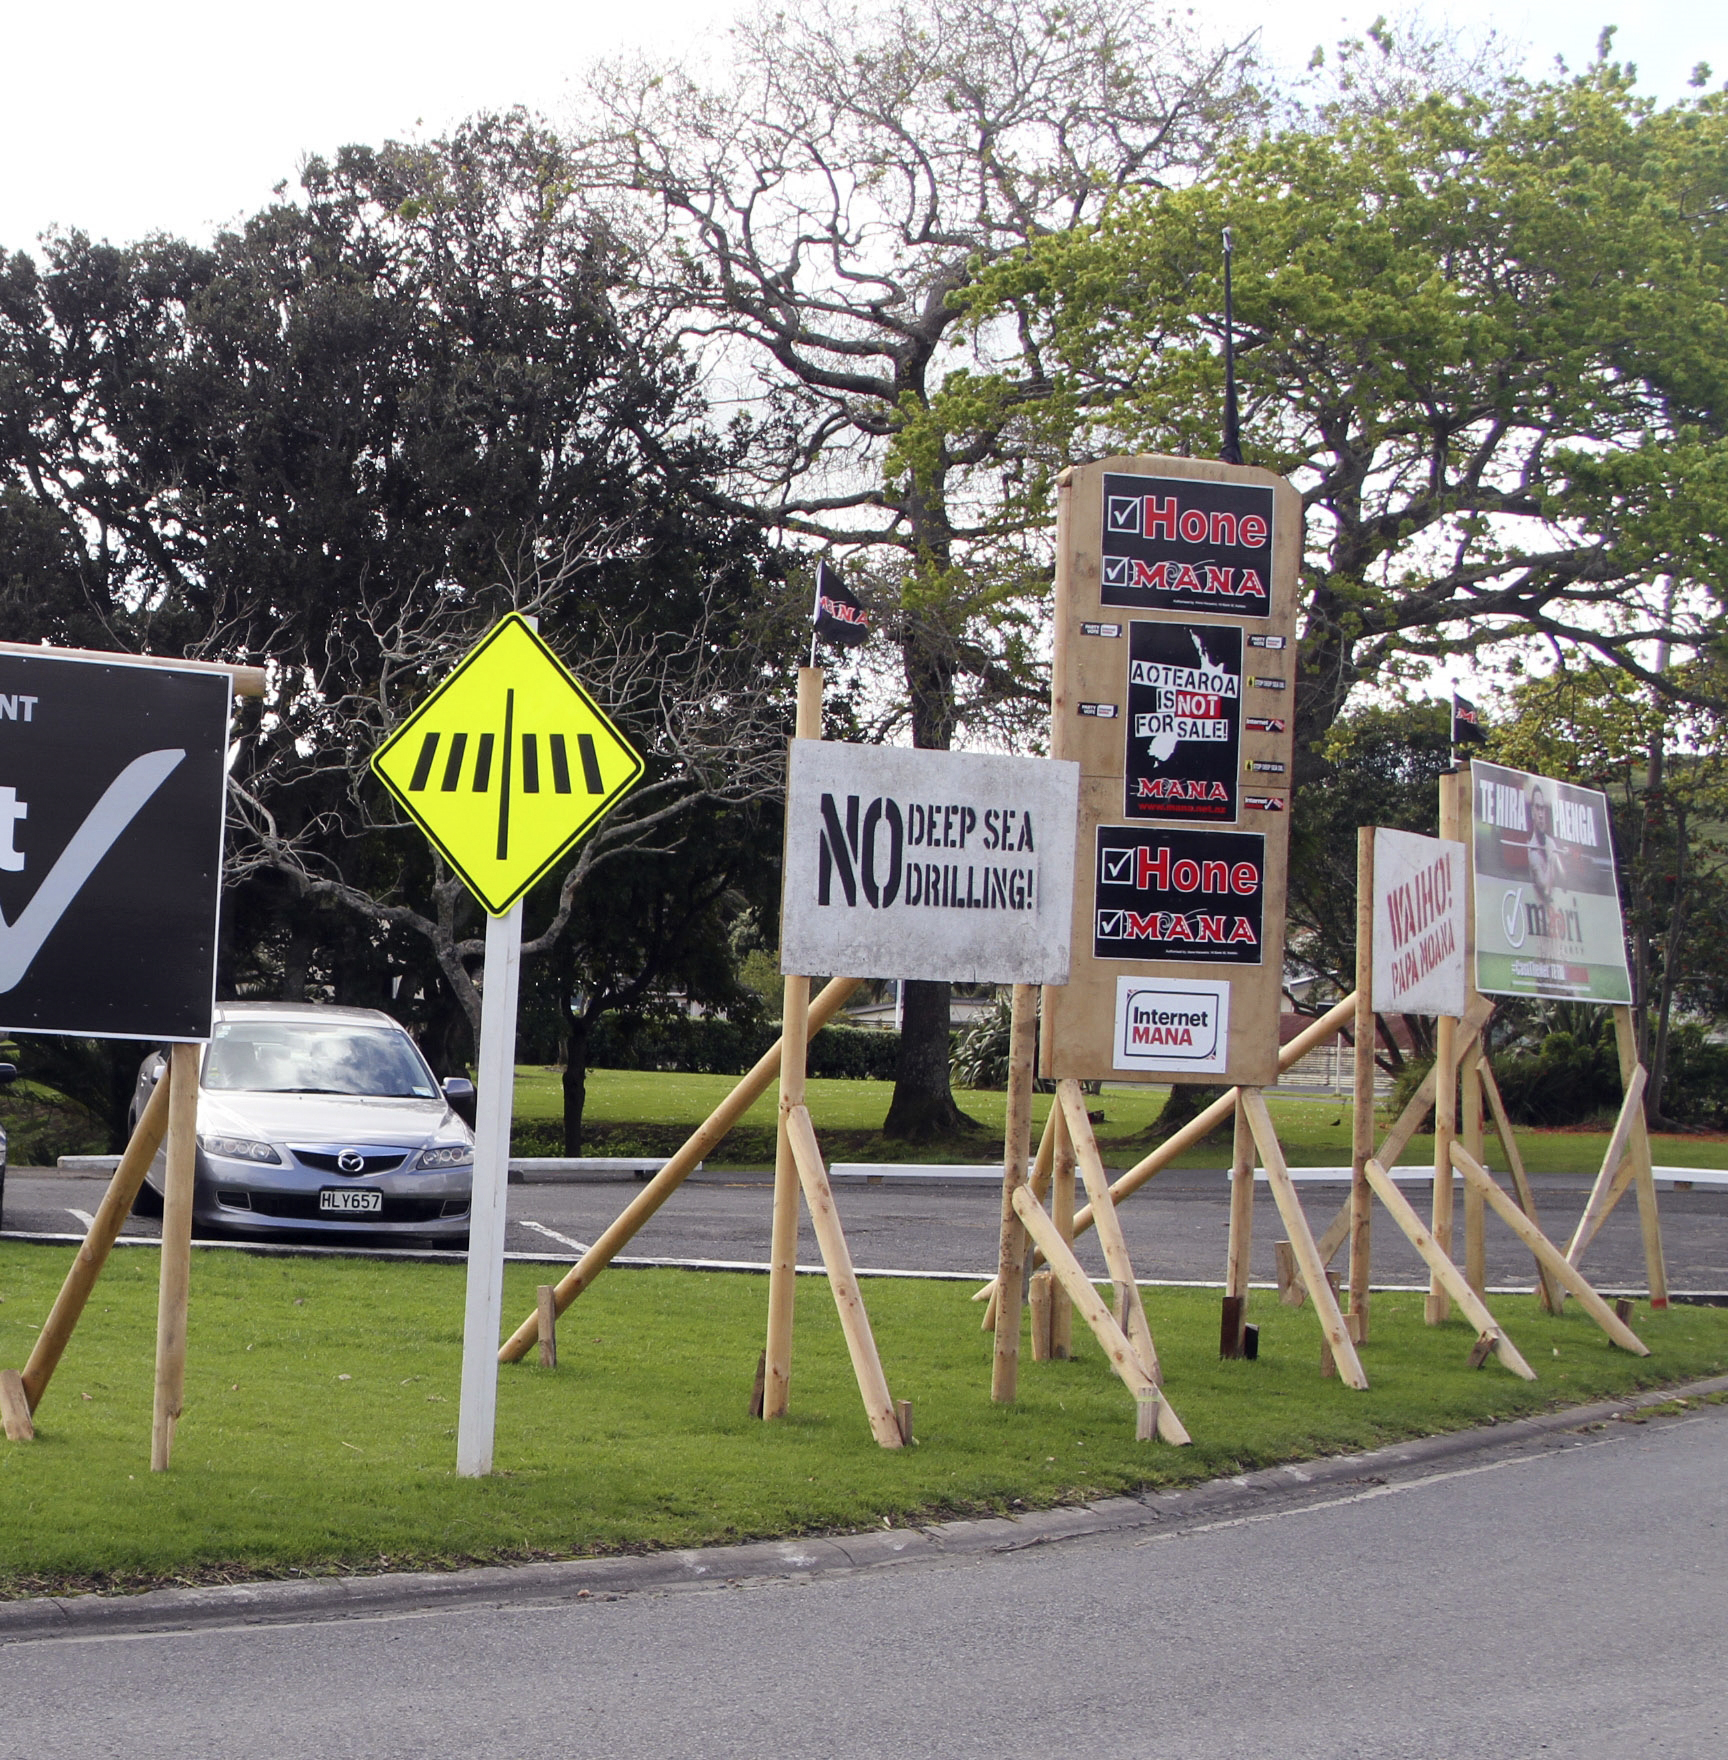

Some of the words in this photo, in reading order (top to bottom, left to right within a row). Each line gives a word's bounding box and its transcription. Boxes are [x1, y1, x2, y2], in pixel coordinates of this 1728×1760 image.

[1143, 495, 1267, 548] Hone
[1129, 560, 1266, 598] MANA
[1132, 662, 1236, 696] AOTEAROA
[1158, 690, 1174, 709] IS
[1177, 694, 1219, 716] NOT
[1136, 714, 1173, 735] FOR
[1176, 719, 1228, 739] SALE!
[1137, 778, 1228, 801] MANA
[907, 804, 976, 849] DEEP
[983, 809, 1035, 852] SEA
[1480, 779, 1495, 825] TE
[1495, 783, 1528, 832] HIRA
[1552, 800, 1598, 847] PAENGA
[818, 793, 903, 909] NO
[905, 862, 1033, 910] DRILLING!
[1137, 846, 1258, 896] Hone
[1387, 852, 1452, 952] WAIHO!
[1124, 910, 1257, 945] MANA
[1391, 948, 1420, 1000] PAPA
[1419, 918, 1456, 978] MOANA
[1132, 1026, 1193, 1046] MANA
[1133, 1006, 1208, 1028] Internet
[321, 1193, 380, 1209] HLY657
